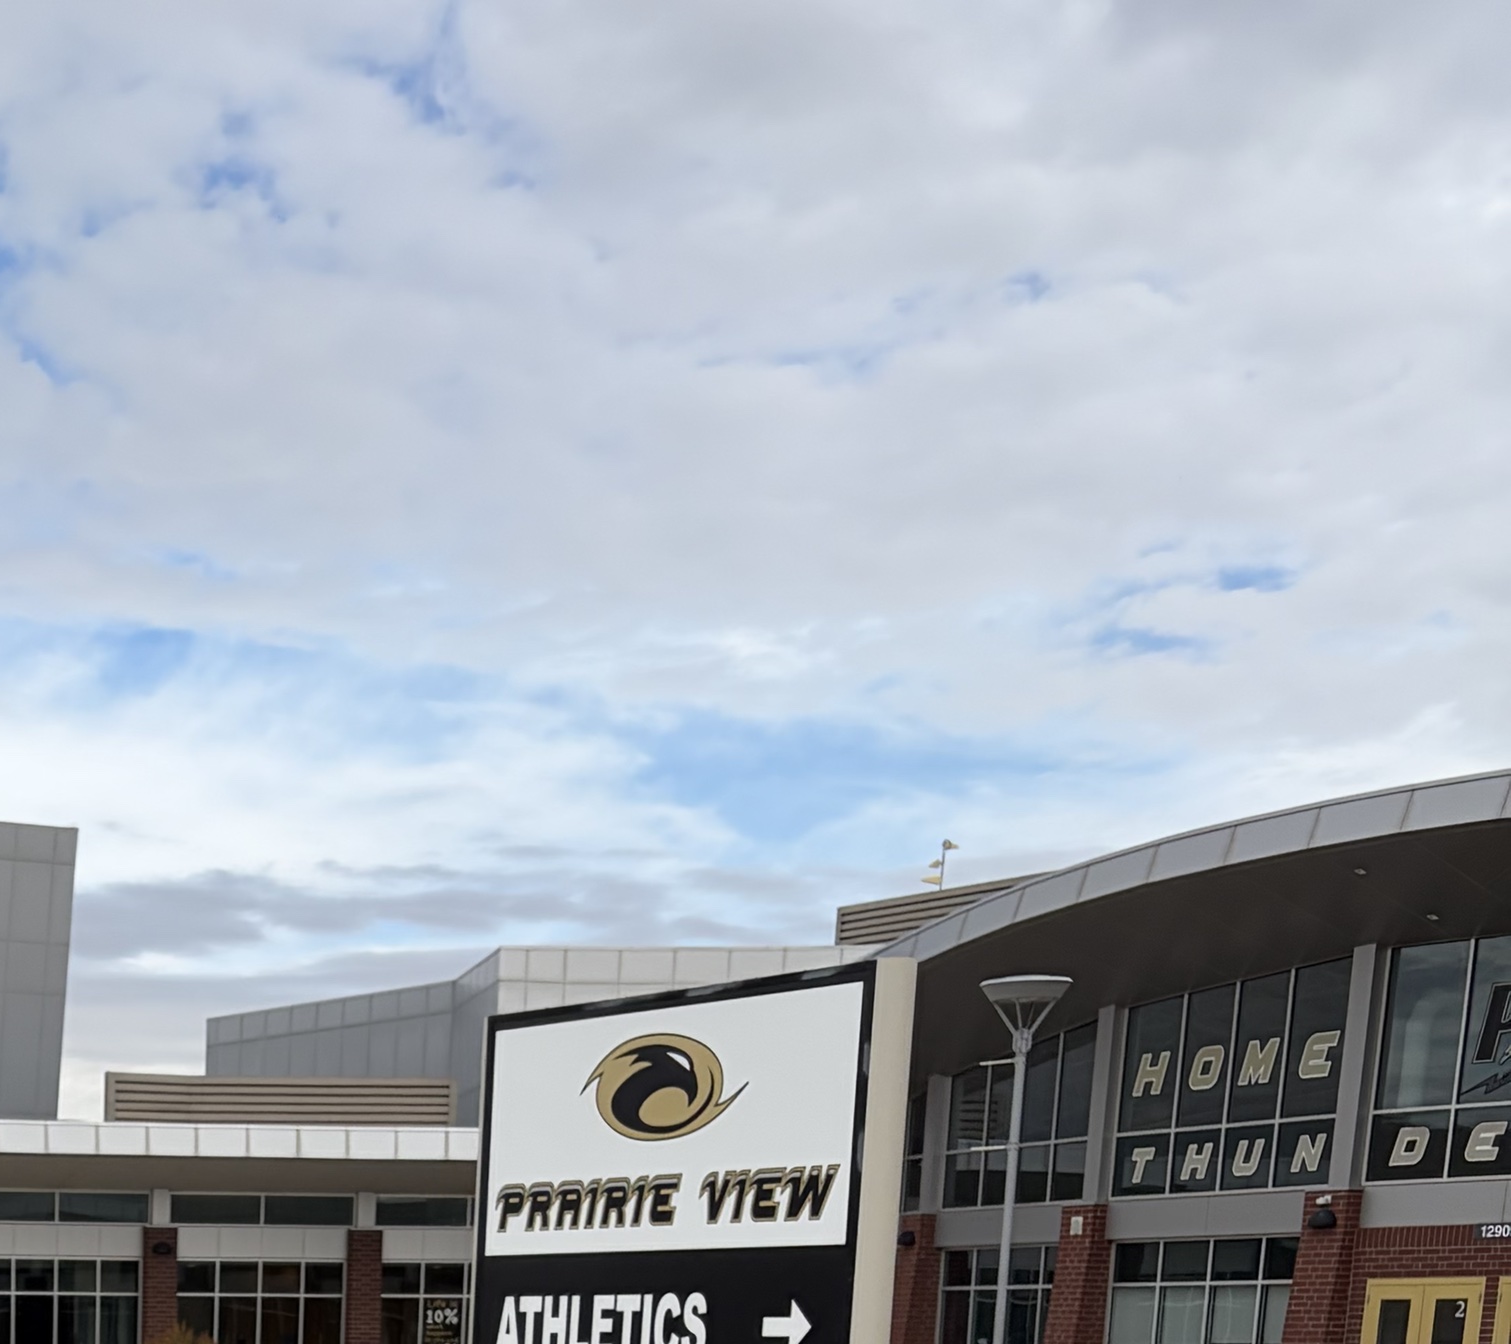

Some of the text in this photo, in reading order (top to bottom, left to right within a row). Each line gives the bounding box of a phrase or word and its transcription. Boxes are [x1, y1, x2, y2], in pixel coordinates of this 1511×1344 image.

[1132, 1029, 1341, 1097] HOME
[496, 1163, 841, 1233] PRAIRIE VIEW
[1481, 1224, 1511, 1238] 1290
[426, 1307, 459, 1325] 10%
[1454, 1301, 1466, 1318] 2
